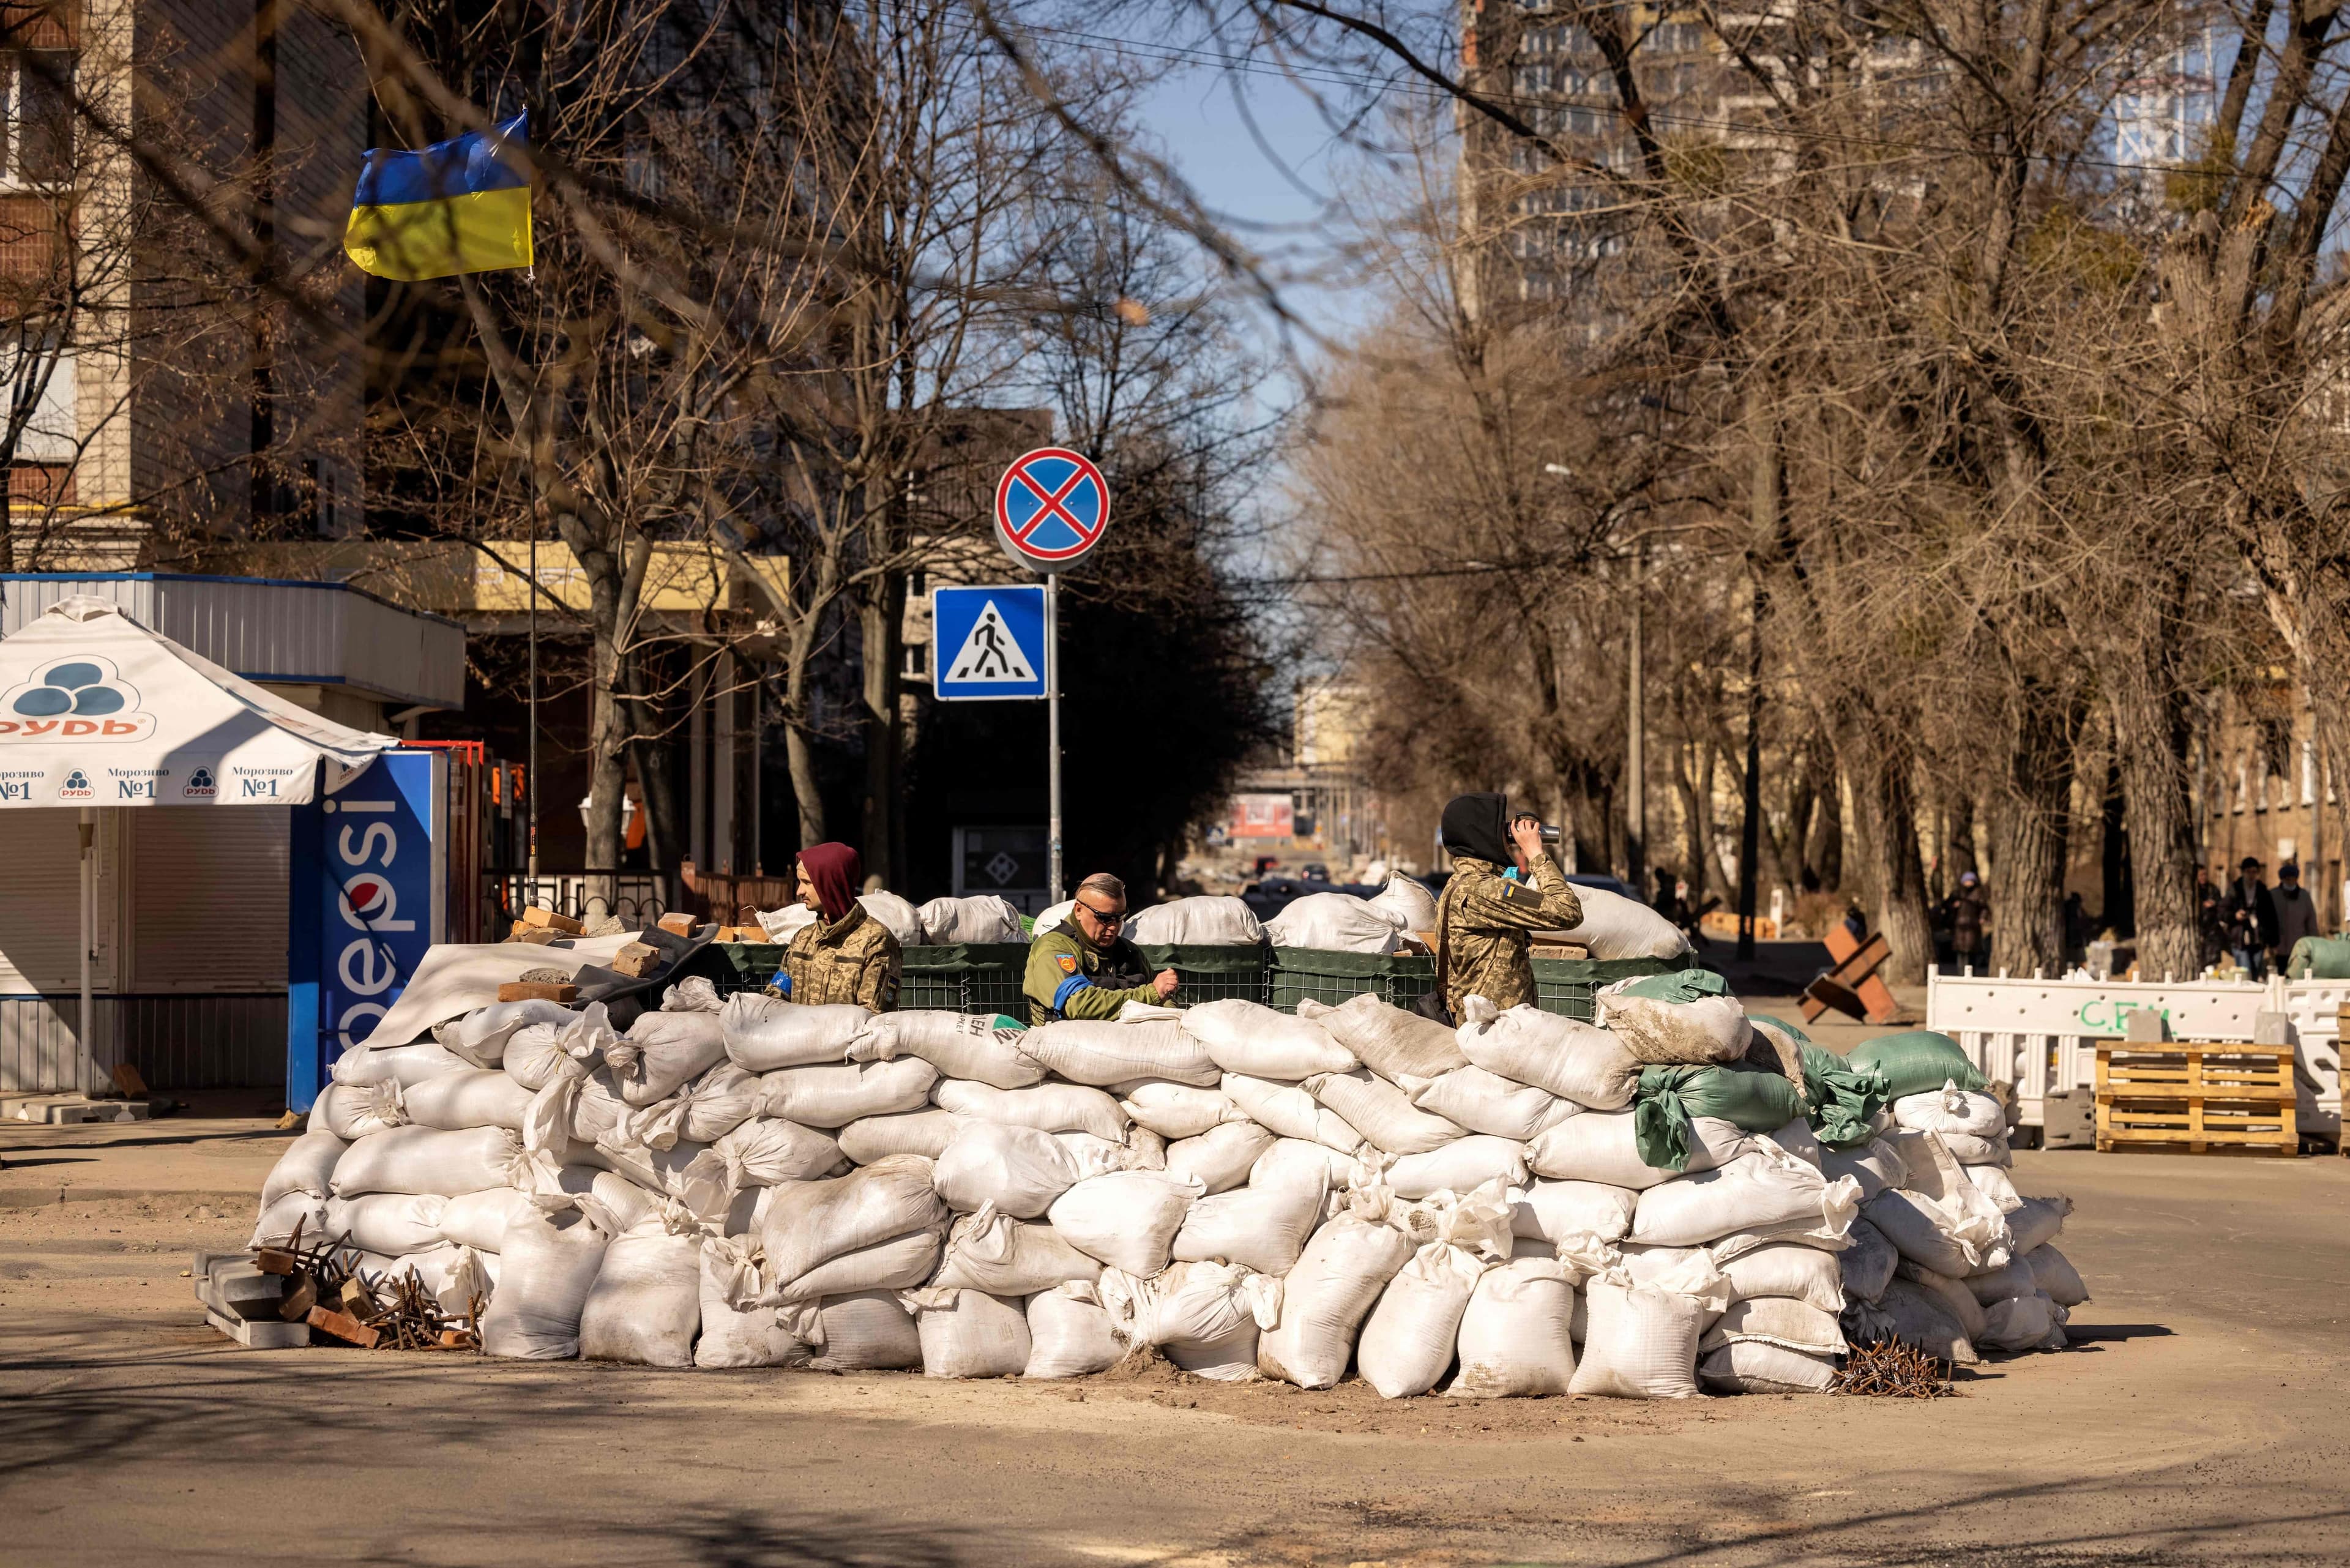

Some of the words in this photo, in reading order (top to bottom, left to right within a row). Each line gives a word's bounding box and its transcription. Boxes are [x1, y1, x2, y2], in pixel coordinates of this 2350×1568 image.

[0, 771, 45, 780] розиво
[108, 768, 170, 778] Морозиво
[232, 766, 293, 777] Морозиво
[118, 780, 157, 798] №1
[242, 778, 280, 797] №1
[956, 1013, 967, 1034] АРКЕТ
